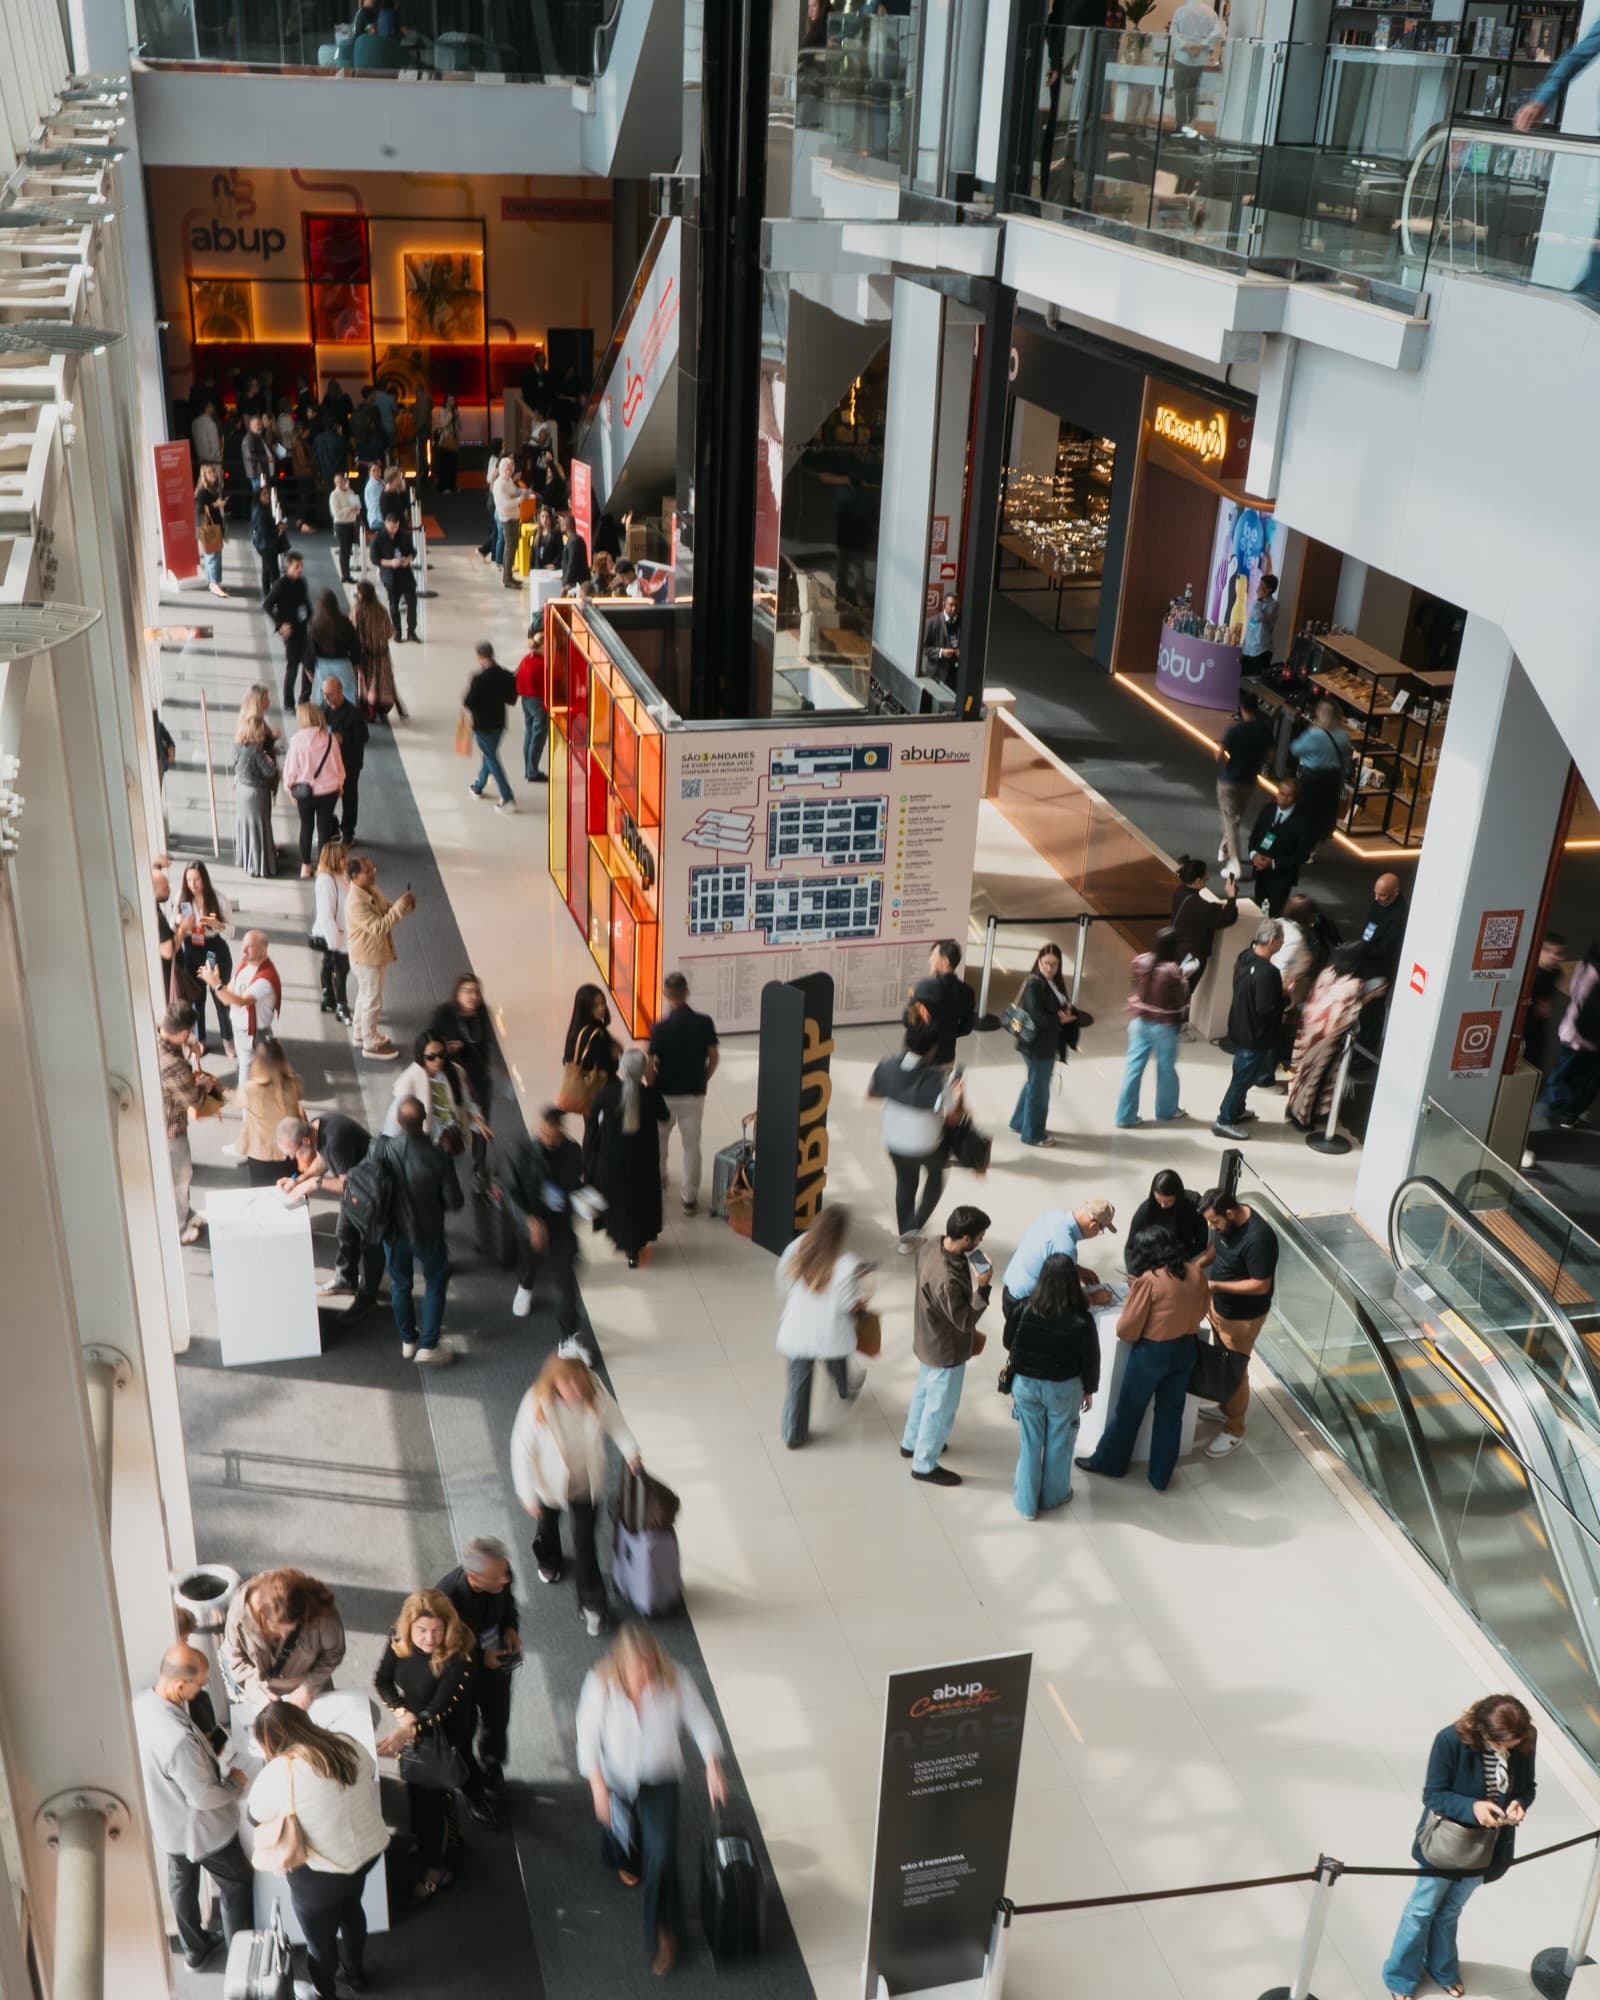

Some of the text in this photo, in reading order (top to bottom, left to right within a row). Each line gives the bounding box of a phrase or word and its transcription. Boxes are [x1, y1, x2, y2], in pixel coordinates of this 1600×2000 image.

[191, 219, 286, 262] abup
[681, 751, 755, 762] SÃO 3 ANDARES
[932, 1681, 983, 1701] abup
[914, 1752, 979, 1769] DOCUMENTO DE
[914, 1770, 957, 1783] COM FOTO
[949, 1782, 960, 1790] DE
[900, 1861, 918, 1871] NÃO
